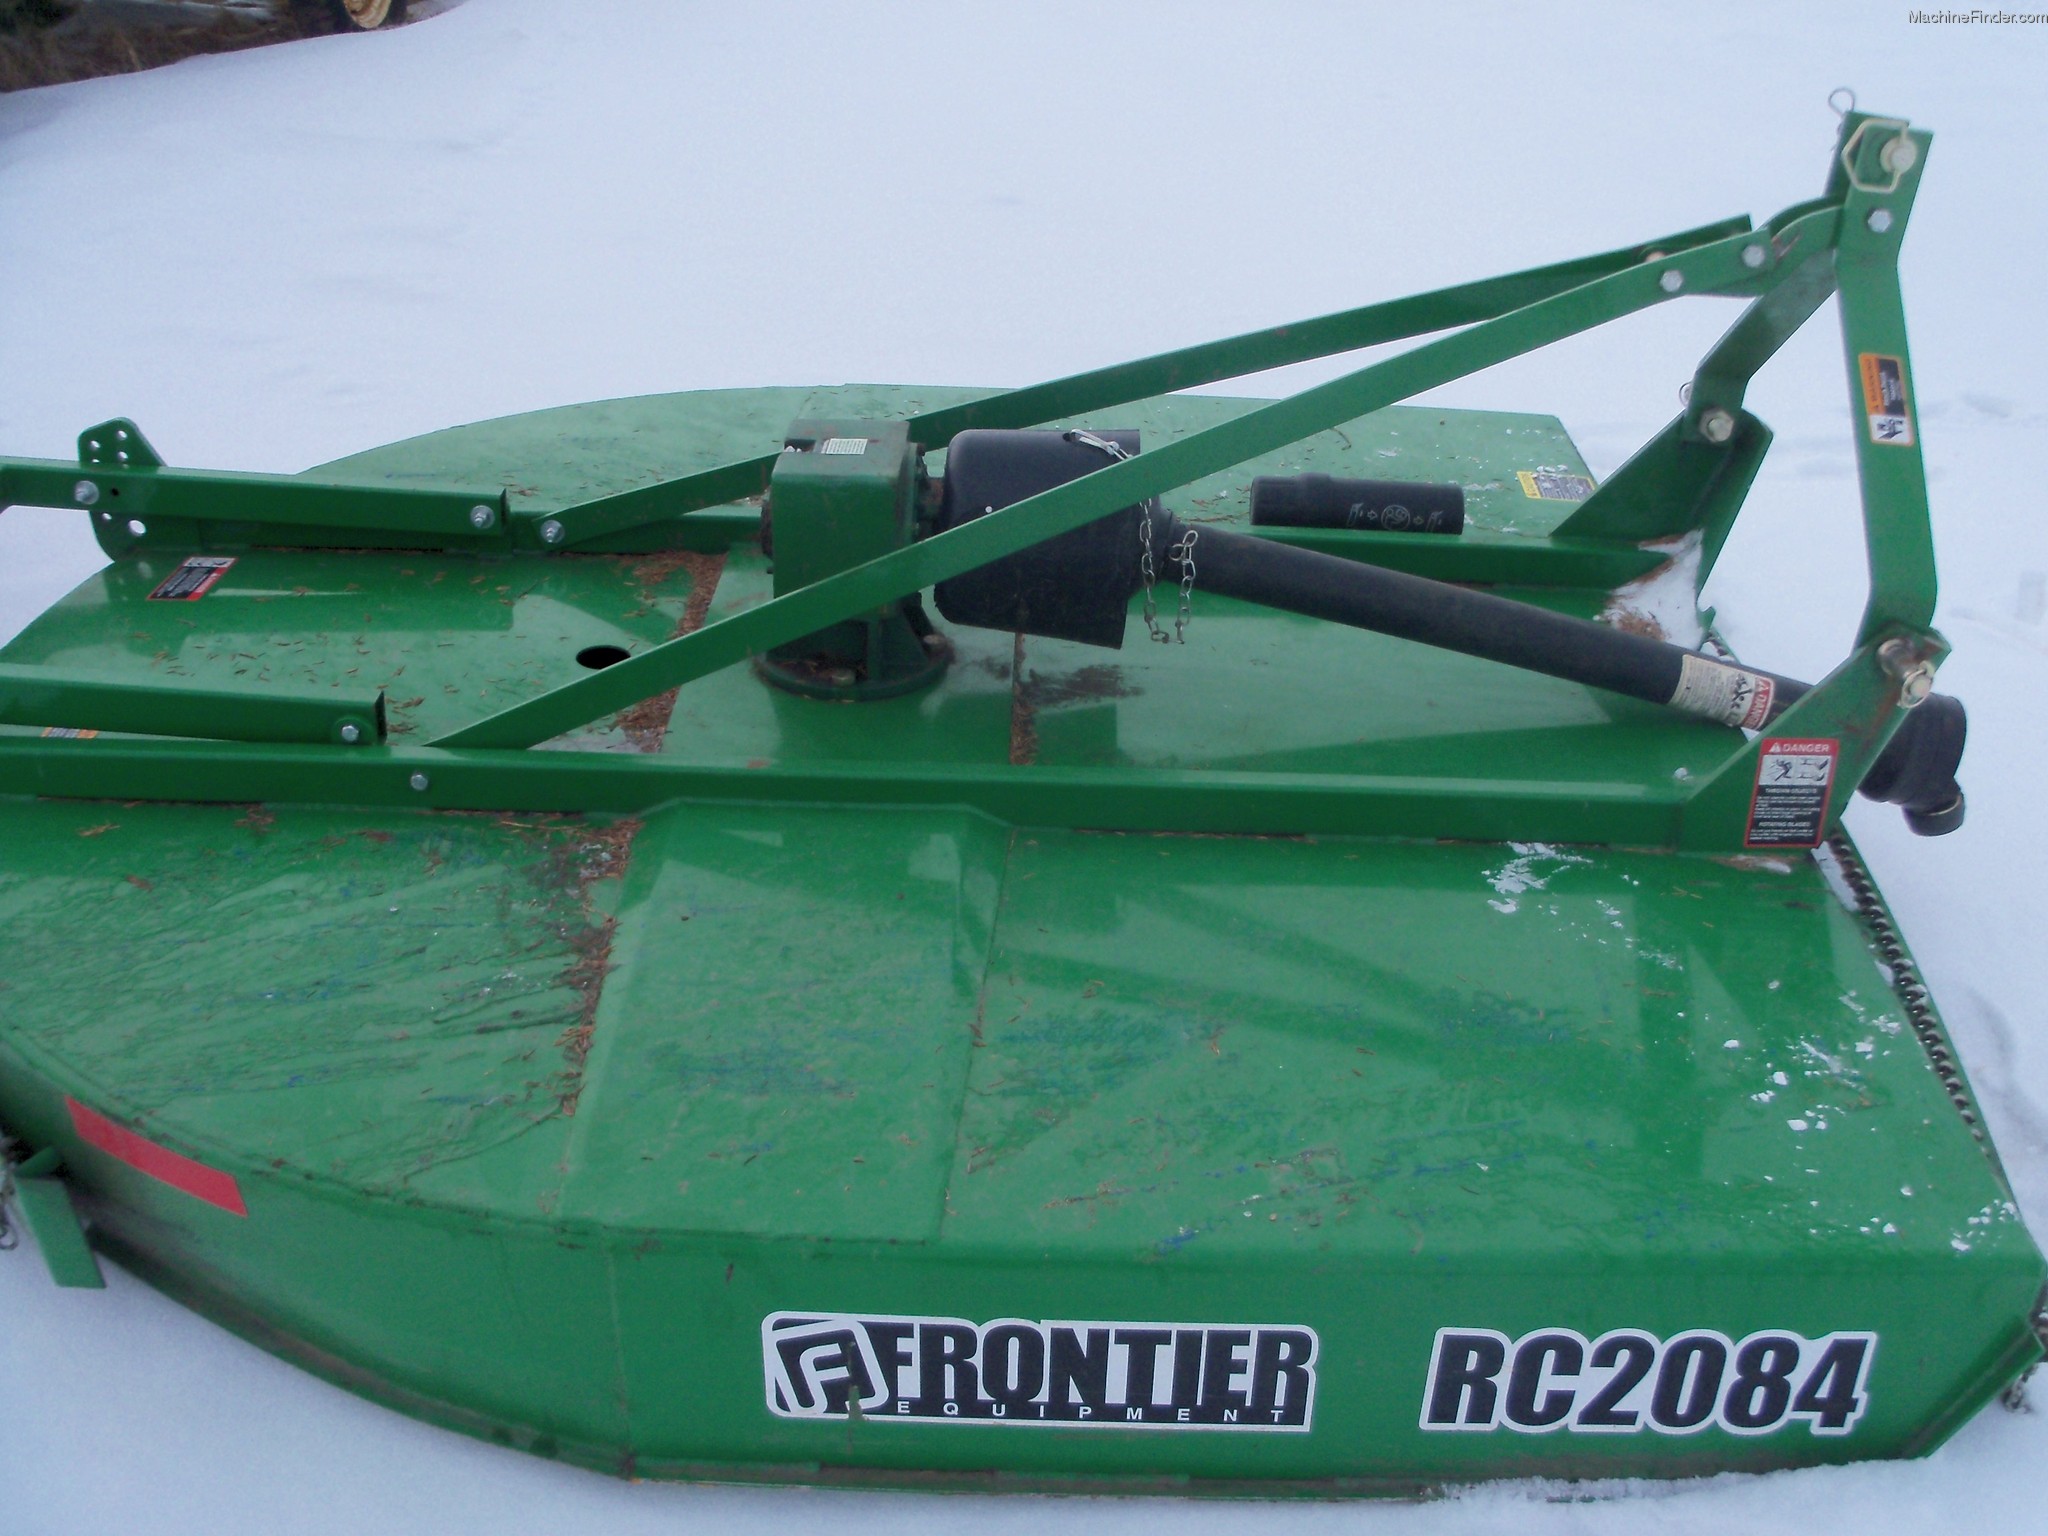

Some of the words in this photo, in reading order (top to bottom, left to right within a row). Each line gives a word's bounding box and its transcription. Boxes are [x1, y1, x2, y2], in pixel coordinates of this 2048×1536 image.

[1783, 743, 1830, 753] DANGER
[866, 1320, 1314, 1405] FRONTIER
[1425, 1332, 1870, 1428] RC2084
[897, 1401, 1286, 1422] EQUIPMENT
